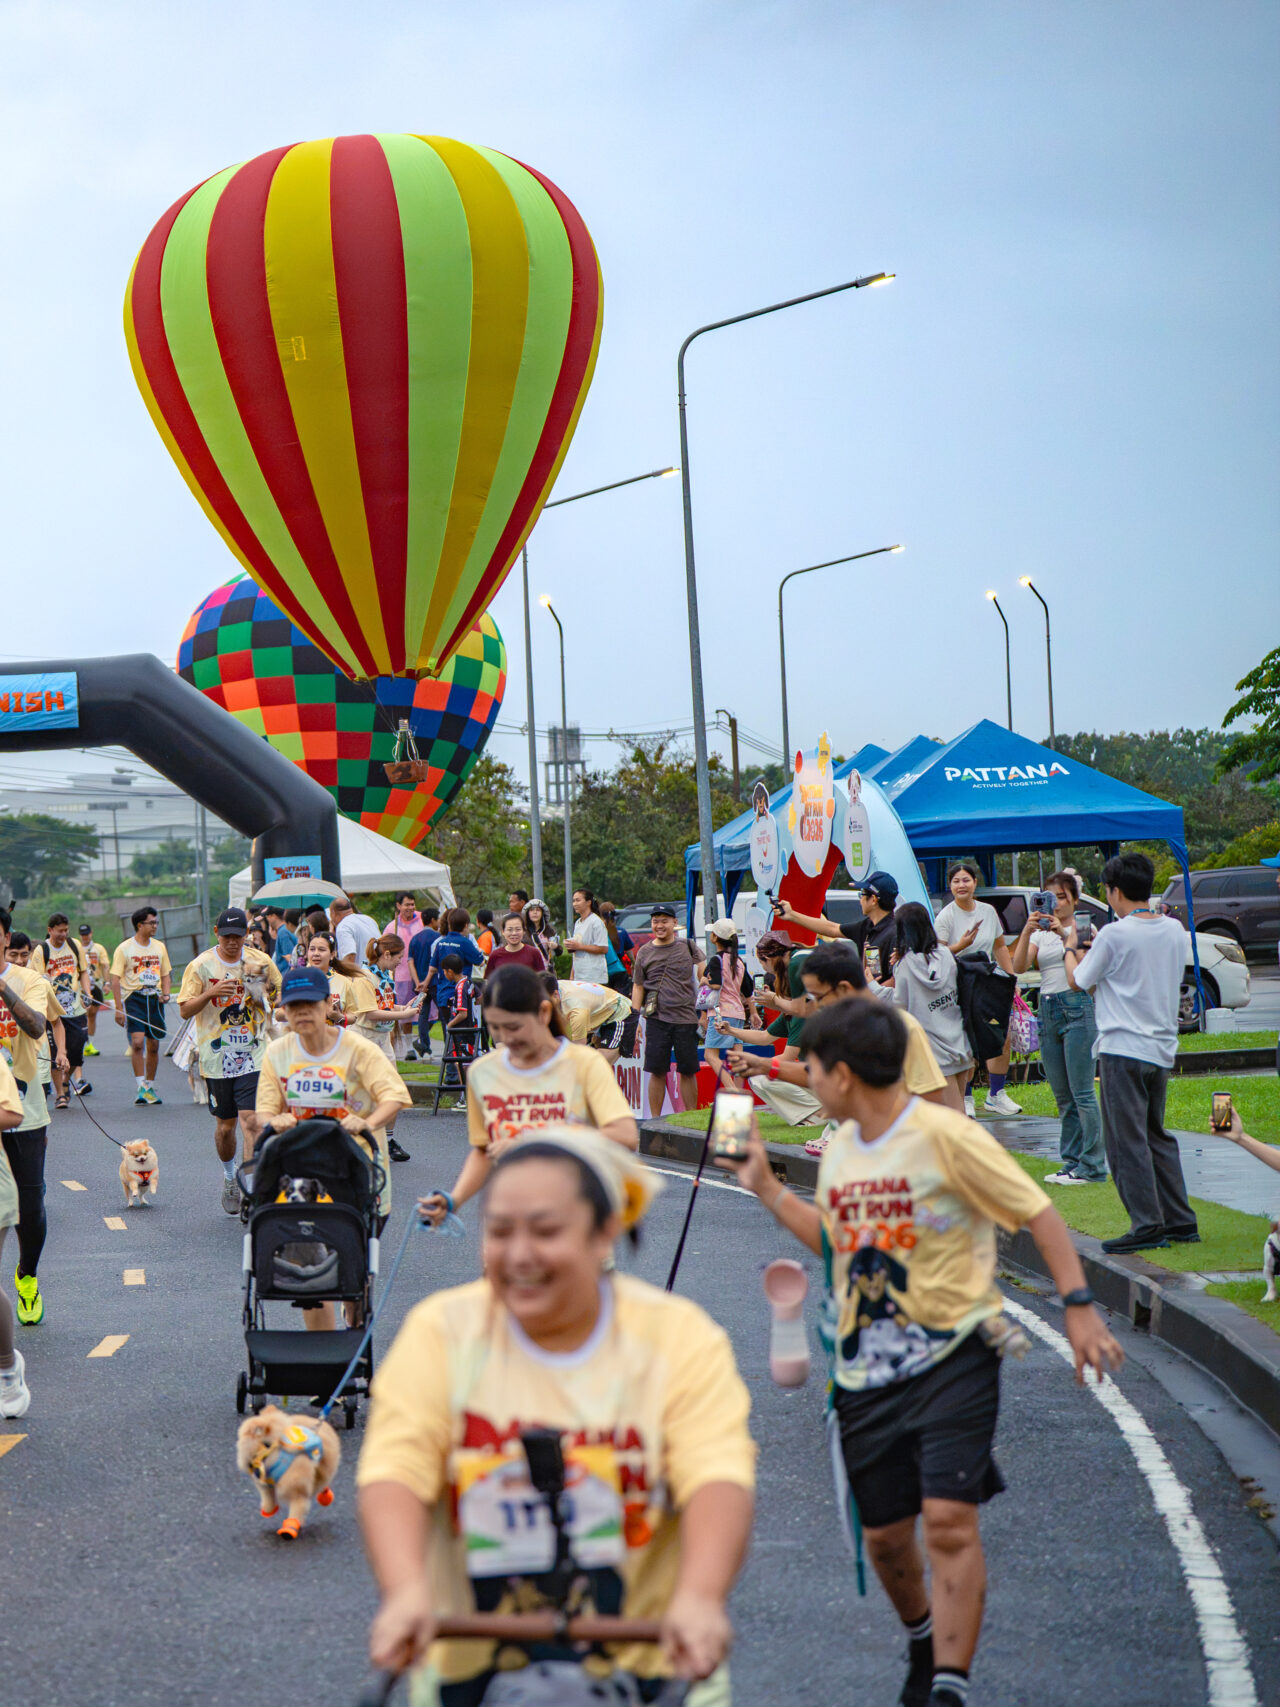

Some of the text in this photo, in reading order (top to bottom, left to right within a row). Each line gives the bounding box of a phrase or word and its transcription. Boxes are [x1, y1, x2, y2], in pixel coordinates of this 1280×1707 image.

[944, 762, 1071, 782] PATTANA
[1009, 780, 1049, 788] TOGETHER
[228, 1034, 249, 1044] 1112
[295, 1080, 334, 1093] 1094
[529, 1106, 565, 1121] RUN
[866, 1197, 914, 1220] RUN
